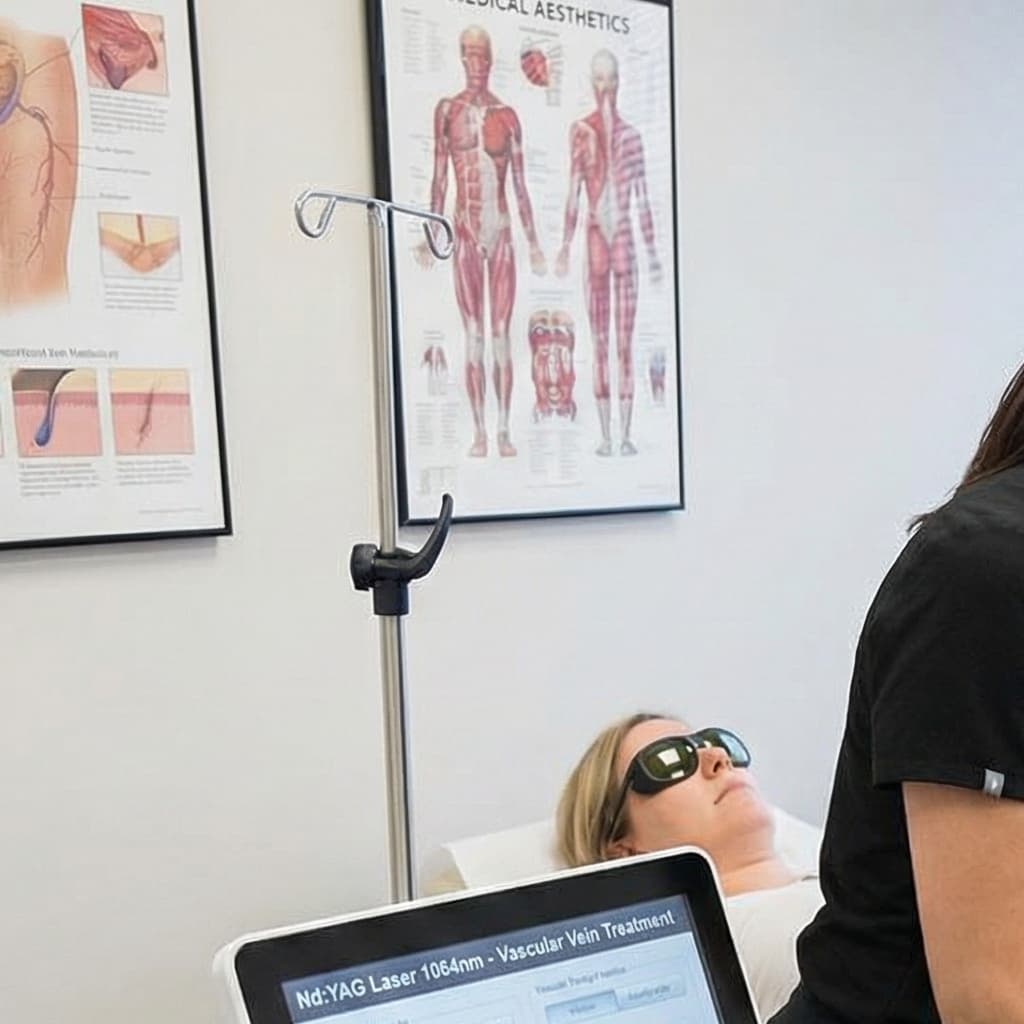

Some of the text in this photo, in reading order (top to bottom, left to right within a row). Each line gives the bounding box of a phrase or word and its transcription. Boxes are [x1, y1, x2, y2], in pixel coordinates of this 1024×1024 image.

[448, 0, 529, 15] ICAL
[534, 1, 631, 34] AESTHETICS
[295, 978, 367, 1010] Nd:YAG
[368, 970, 417, 994] Laser
[420, 955, 485, 981] 1064nm
[495, 936, 565, 964] Vascular
[565, 928, 601, 948] Vein
[600, 909, 676, 940] Treatment
